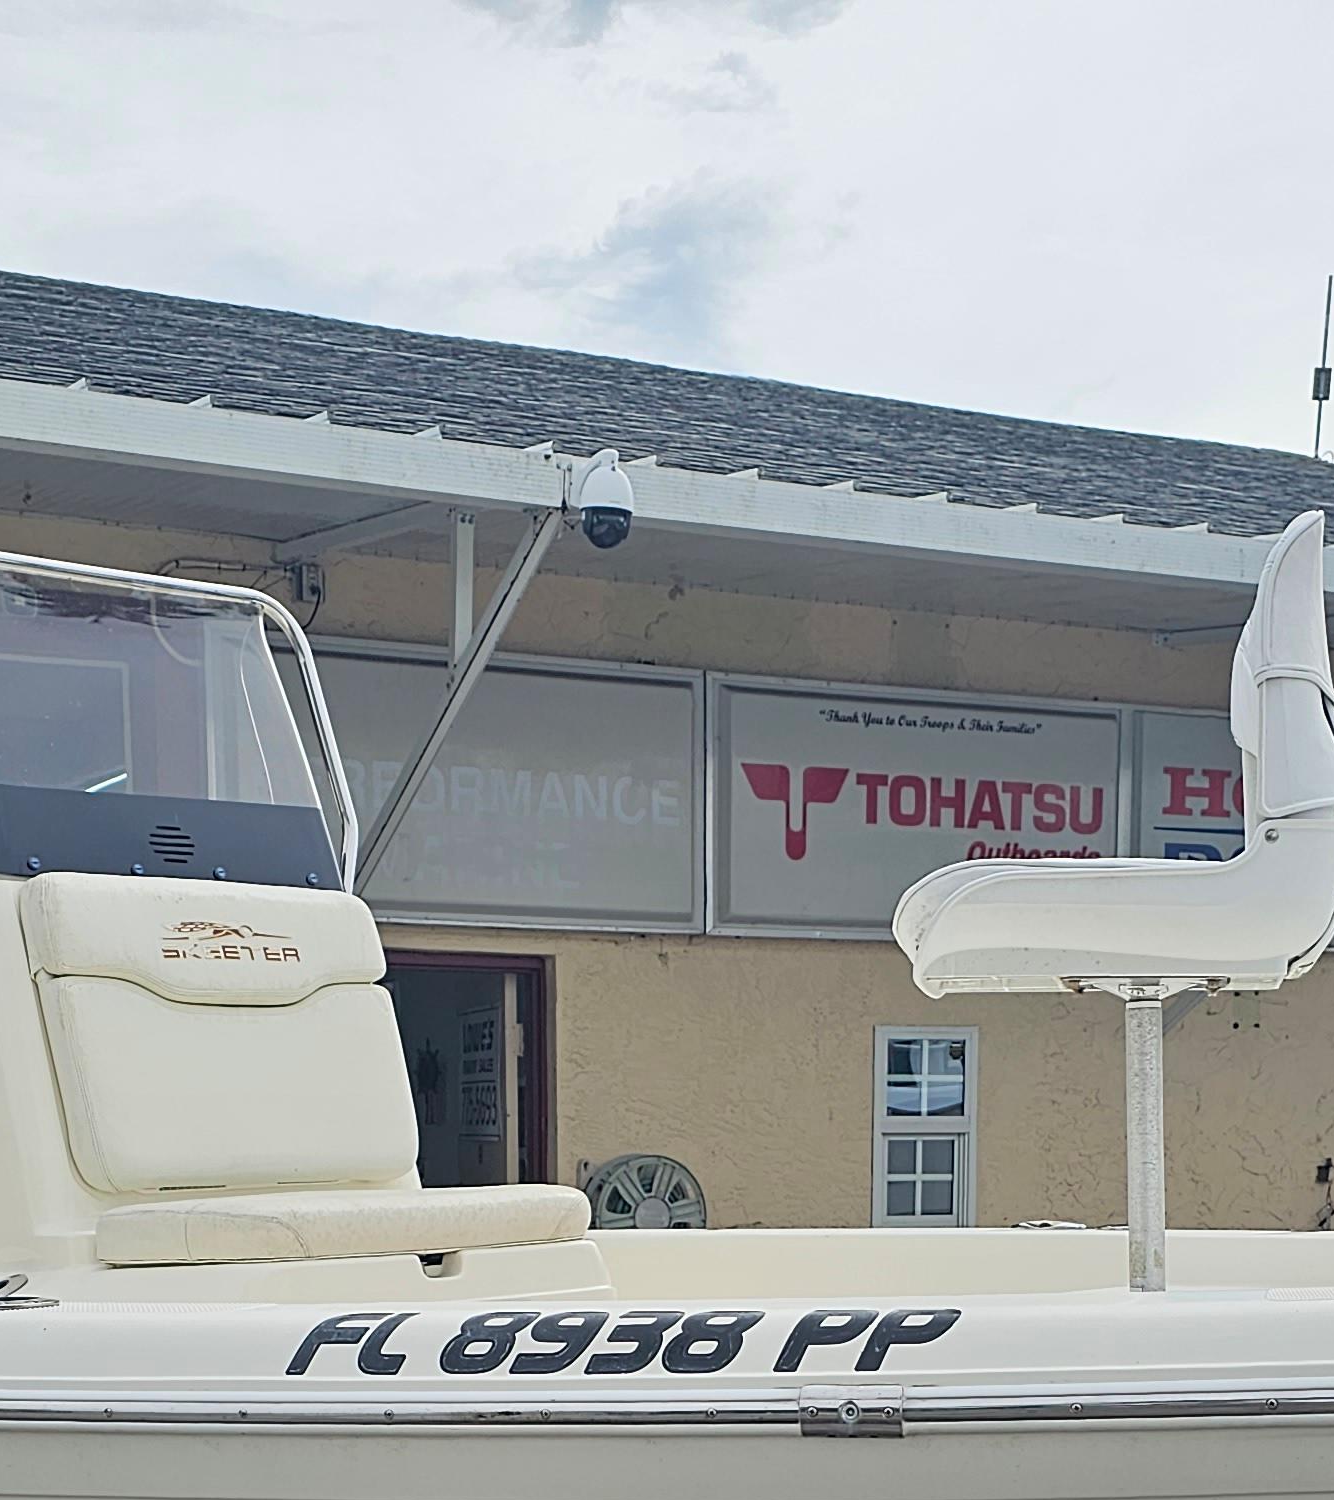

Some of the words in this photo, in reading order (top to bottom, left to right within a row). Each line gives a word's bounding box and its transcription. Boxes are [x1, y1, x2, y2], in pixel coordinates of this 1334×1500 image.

[861, 712, 883, 728] You
[885, 716, 895, 726] to
[897, 714, 917, 727] Our
[919, 715, 954, 732] Troops
[957, 717, 966, 731] &
[968, 718, 994, 733] Their
[856, 772, 1104, 835] TOHATSU
[284, 1311, 422, 1376] FL
[438, 1310, 766, 1376] 8938
[772, 1308, 961, 1373] PP
